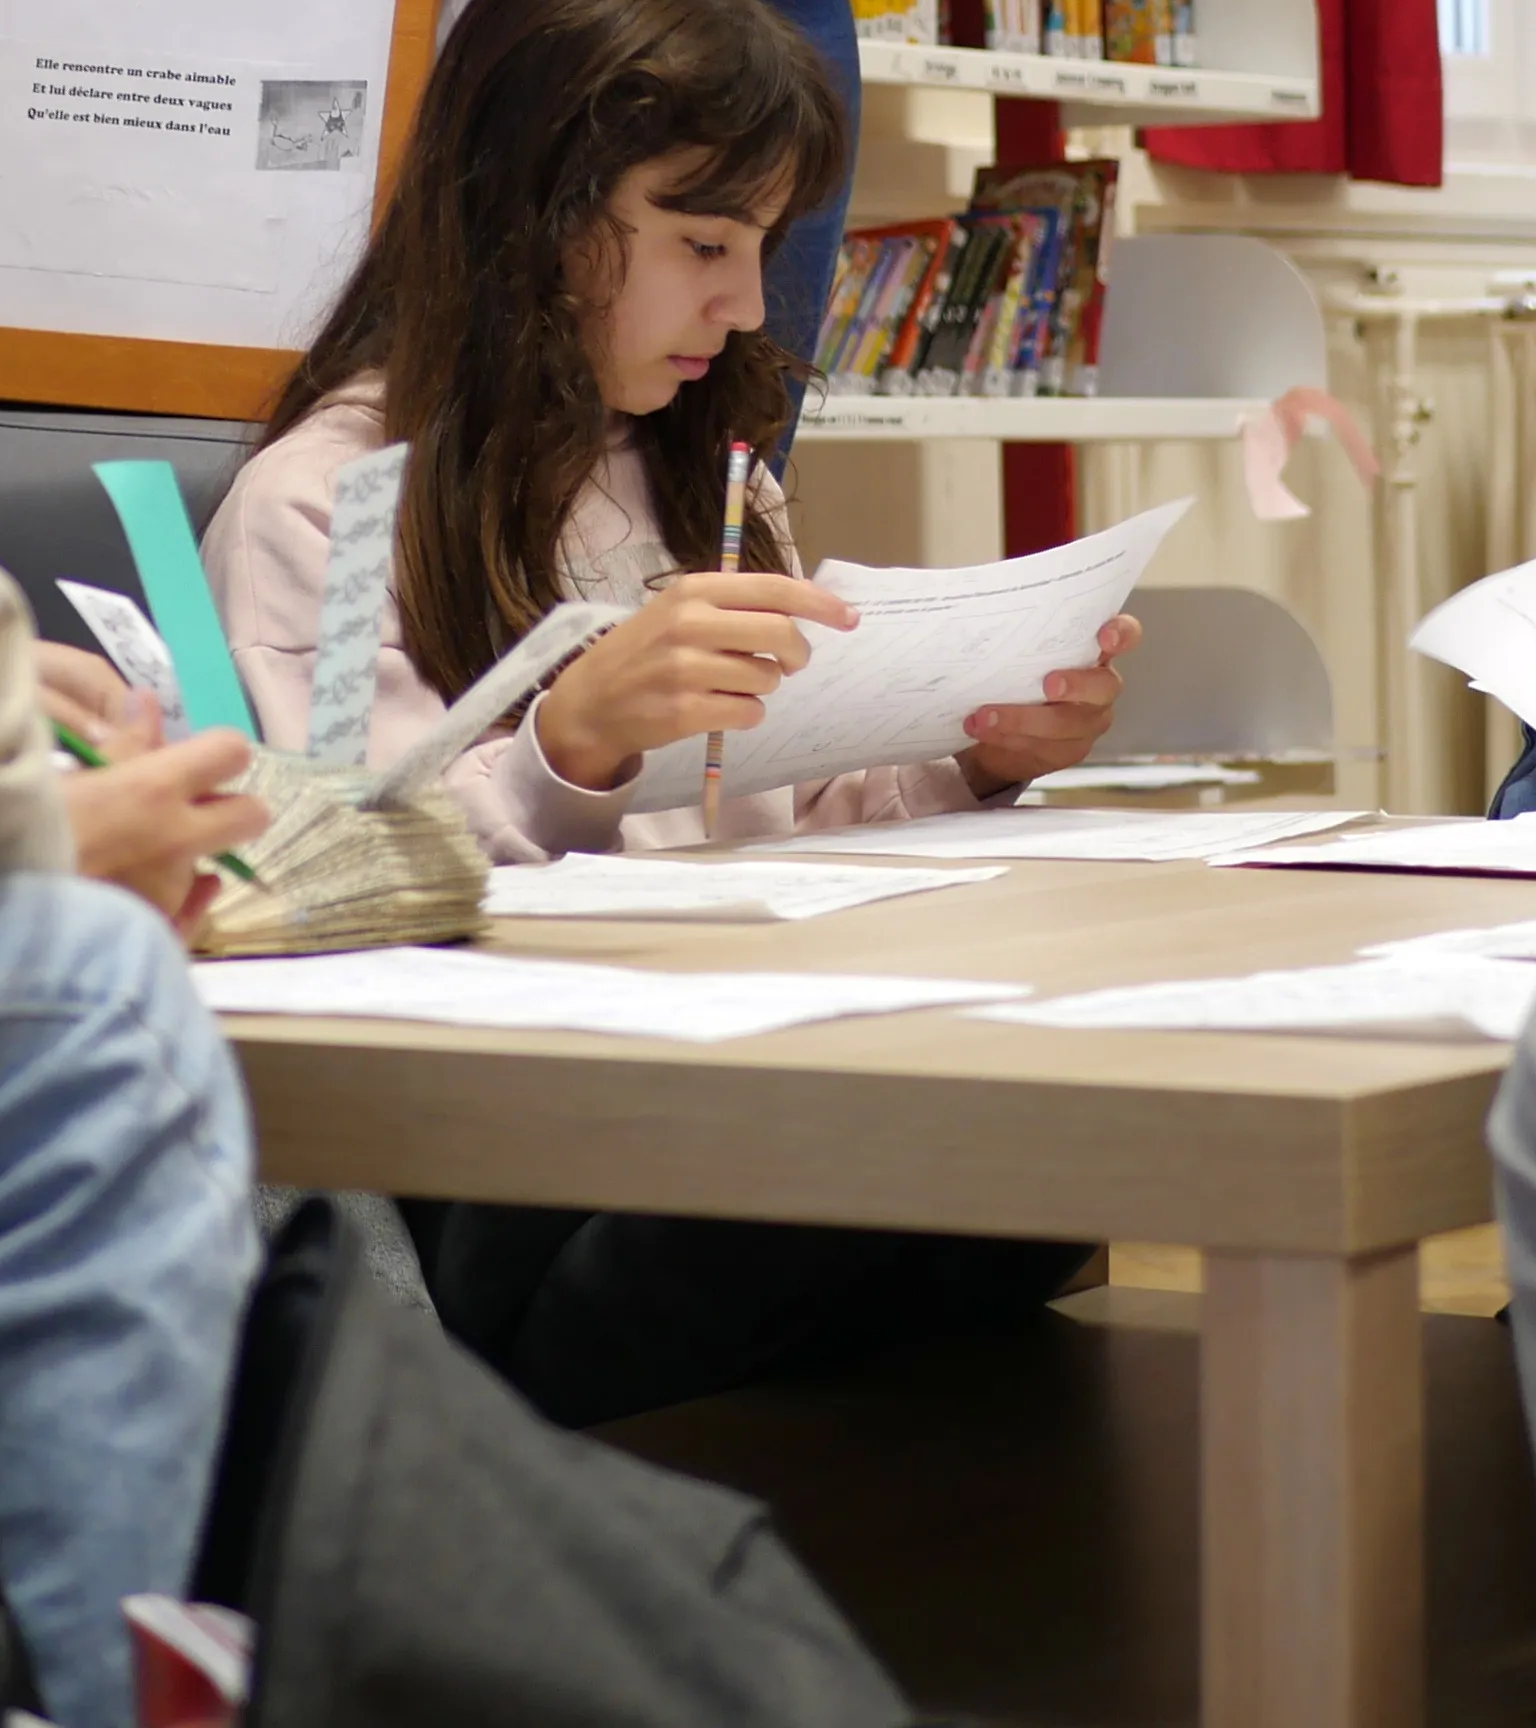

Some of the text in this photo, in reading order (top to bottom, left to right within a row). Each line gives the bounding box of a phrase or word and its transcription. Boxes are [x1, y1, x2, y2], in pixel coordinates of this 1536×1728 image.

[35, 57, 237, 87] Elle rencontre un crabe aimable
[32, 82, 233, 112] Et lui déclare entre deux vagues
[27, 107, 231, 137] Qu'elle est bien mieux dans l'eau
